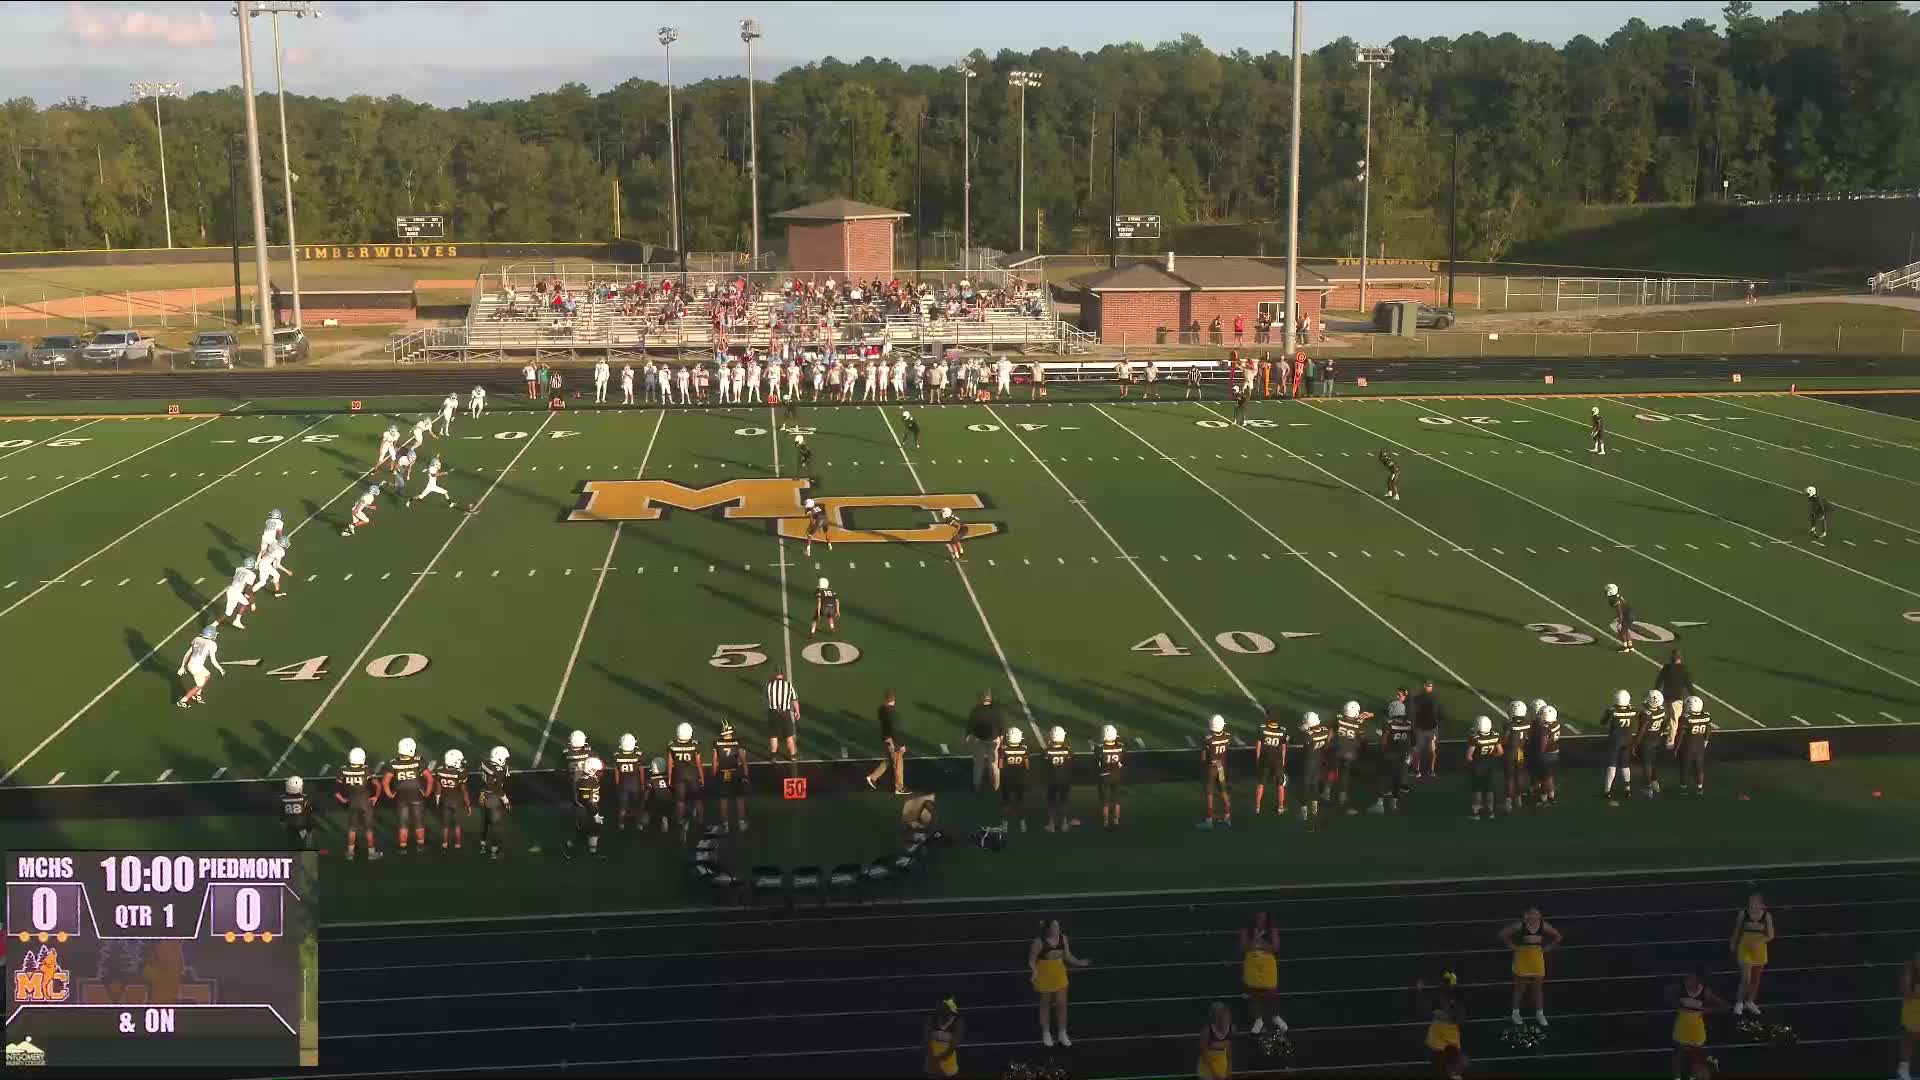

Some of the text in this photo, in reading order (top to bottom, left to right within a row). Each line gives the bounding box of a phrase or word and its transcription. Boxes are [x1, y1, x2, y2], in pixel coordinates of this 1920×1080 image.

[566, 478, 999, 543] MC
[1130, 629, 1277, 657] 40
[709, 640, 863, 669] 50
[266, 651, 431, 682] 40
[675, 753, 691, 762] 70
[346, 776, 362, 786] 44
[397, 771, 416, 780] 65
[592, 789, 600, 802] 5
[786, 780, 805, 797] 50
